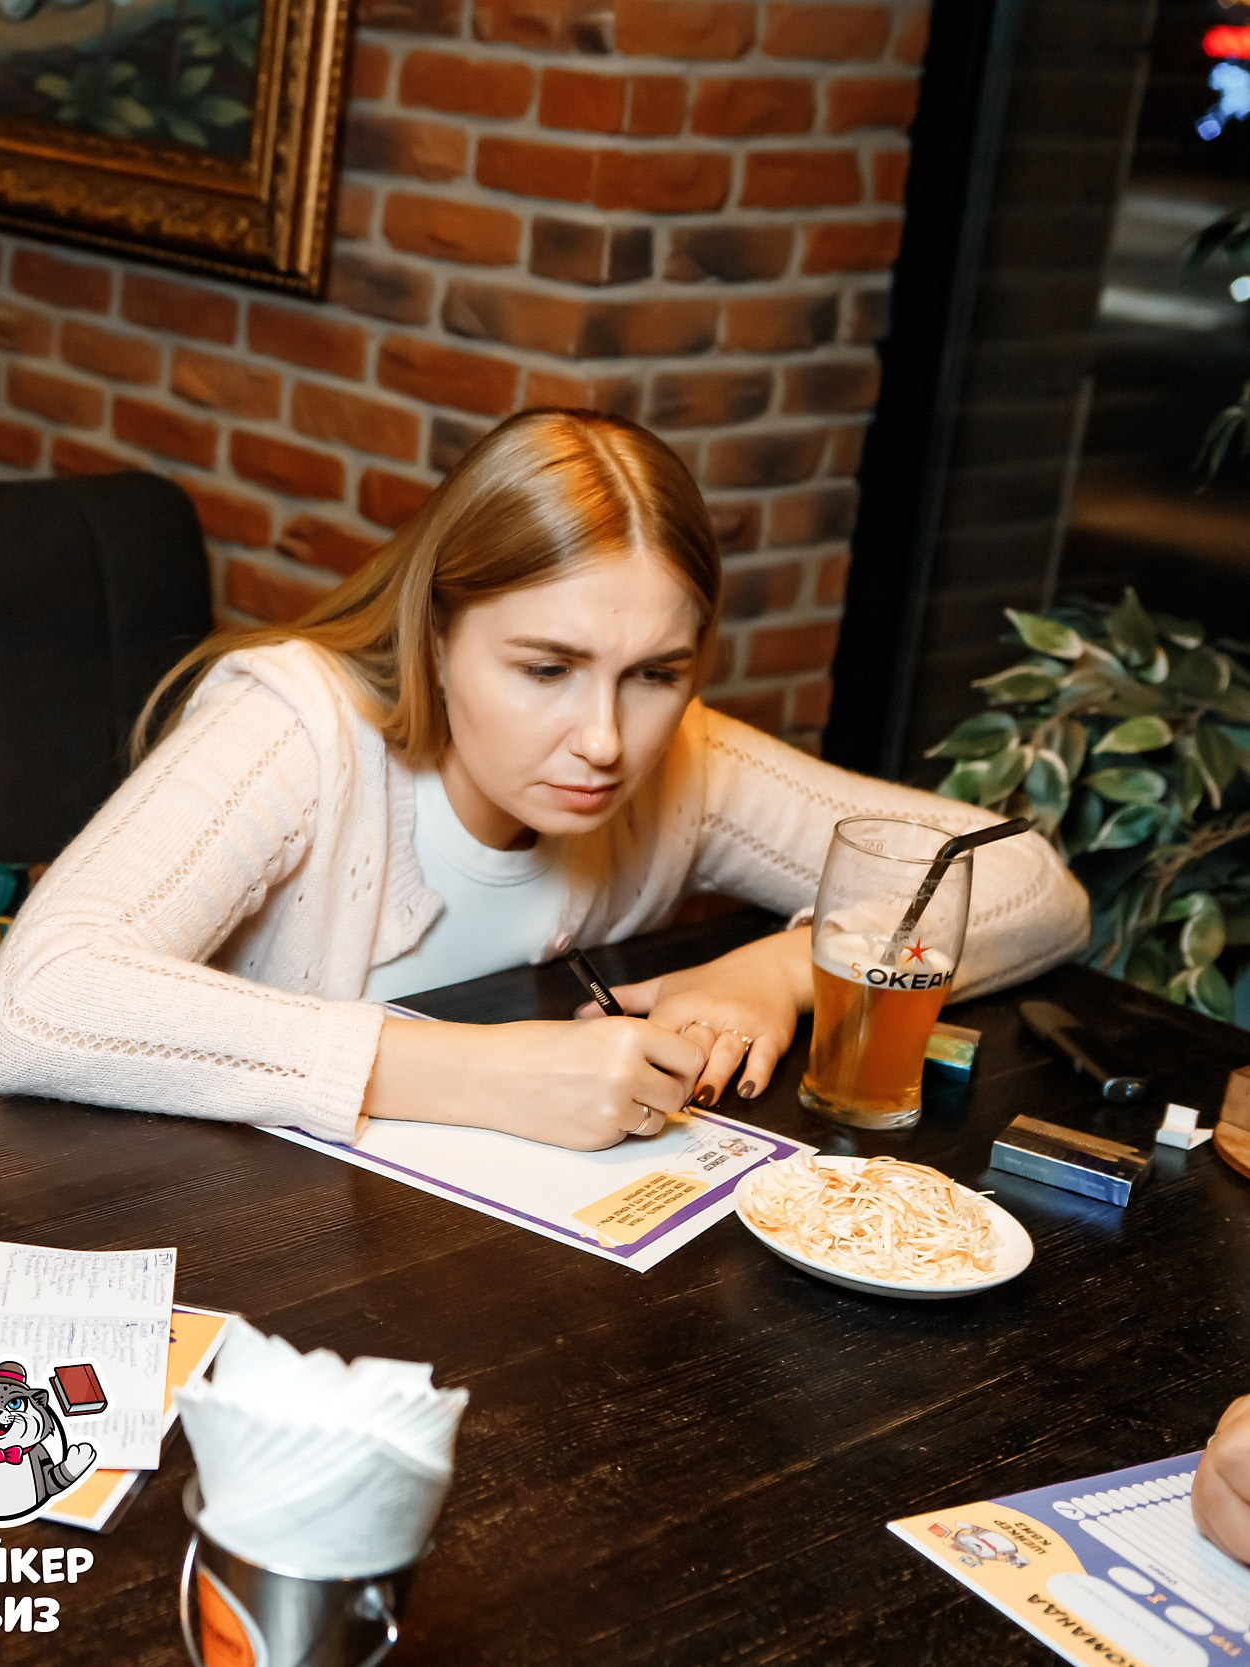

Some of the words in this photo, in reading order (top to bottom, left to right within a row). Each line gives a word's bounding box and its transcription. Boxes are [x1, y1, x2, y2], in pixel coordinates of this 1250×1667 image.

[849, 961, 861, 979] 5
[865, 968, 953, 990] ОКЕАН
[589, 981, 611, 1007] Hilton
[1027, 1593, 1135, 1667] ОМАНДА
